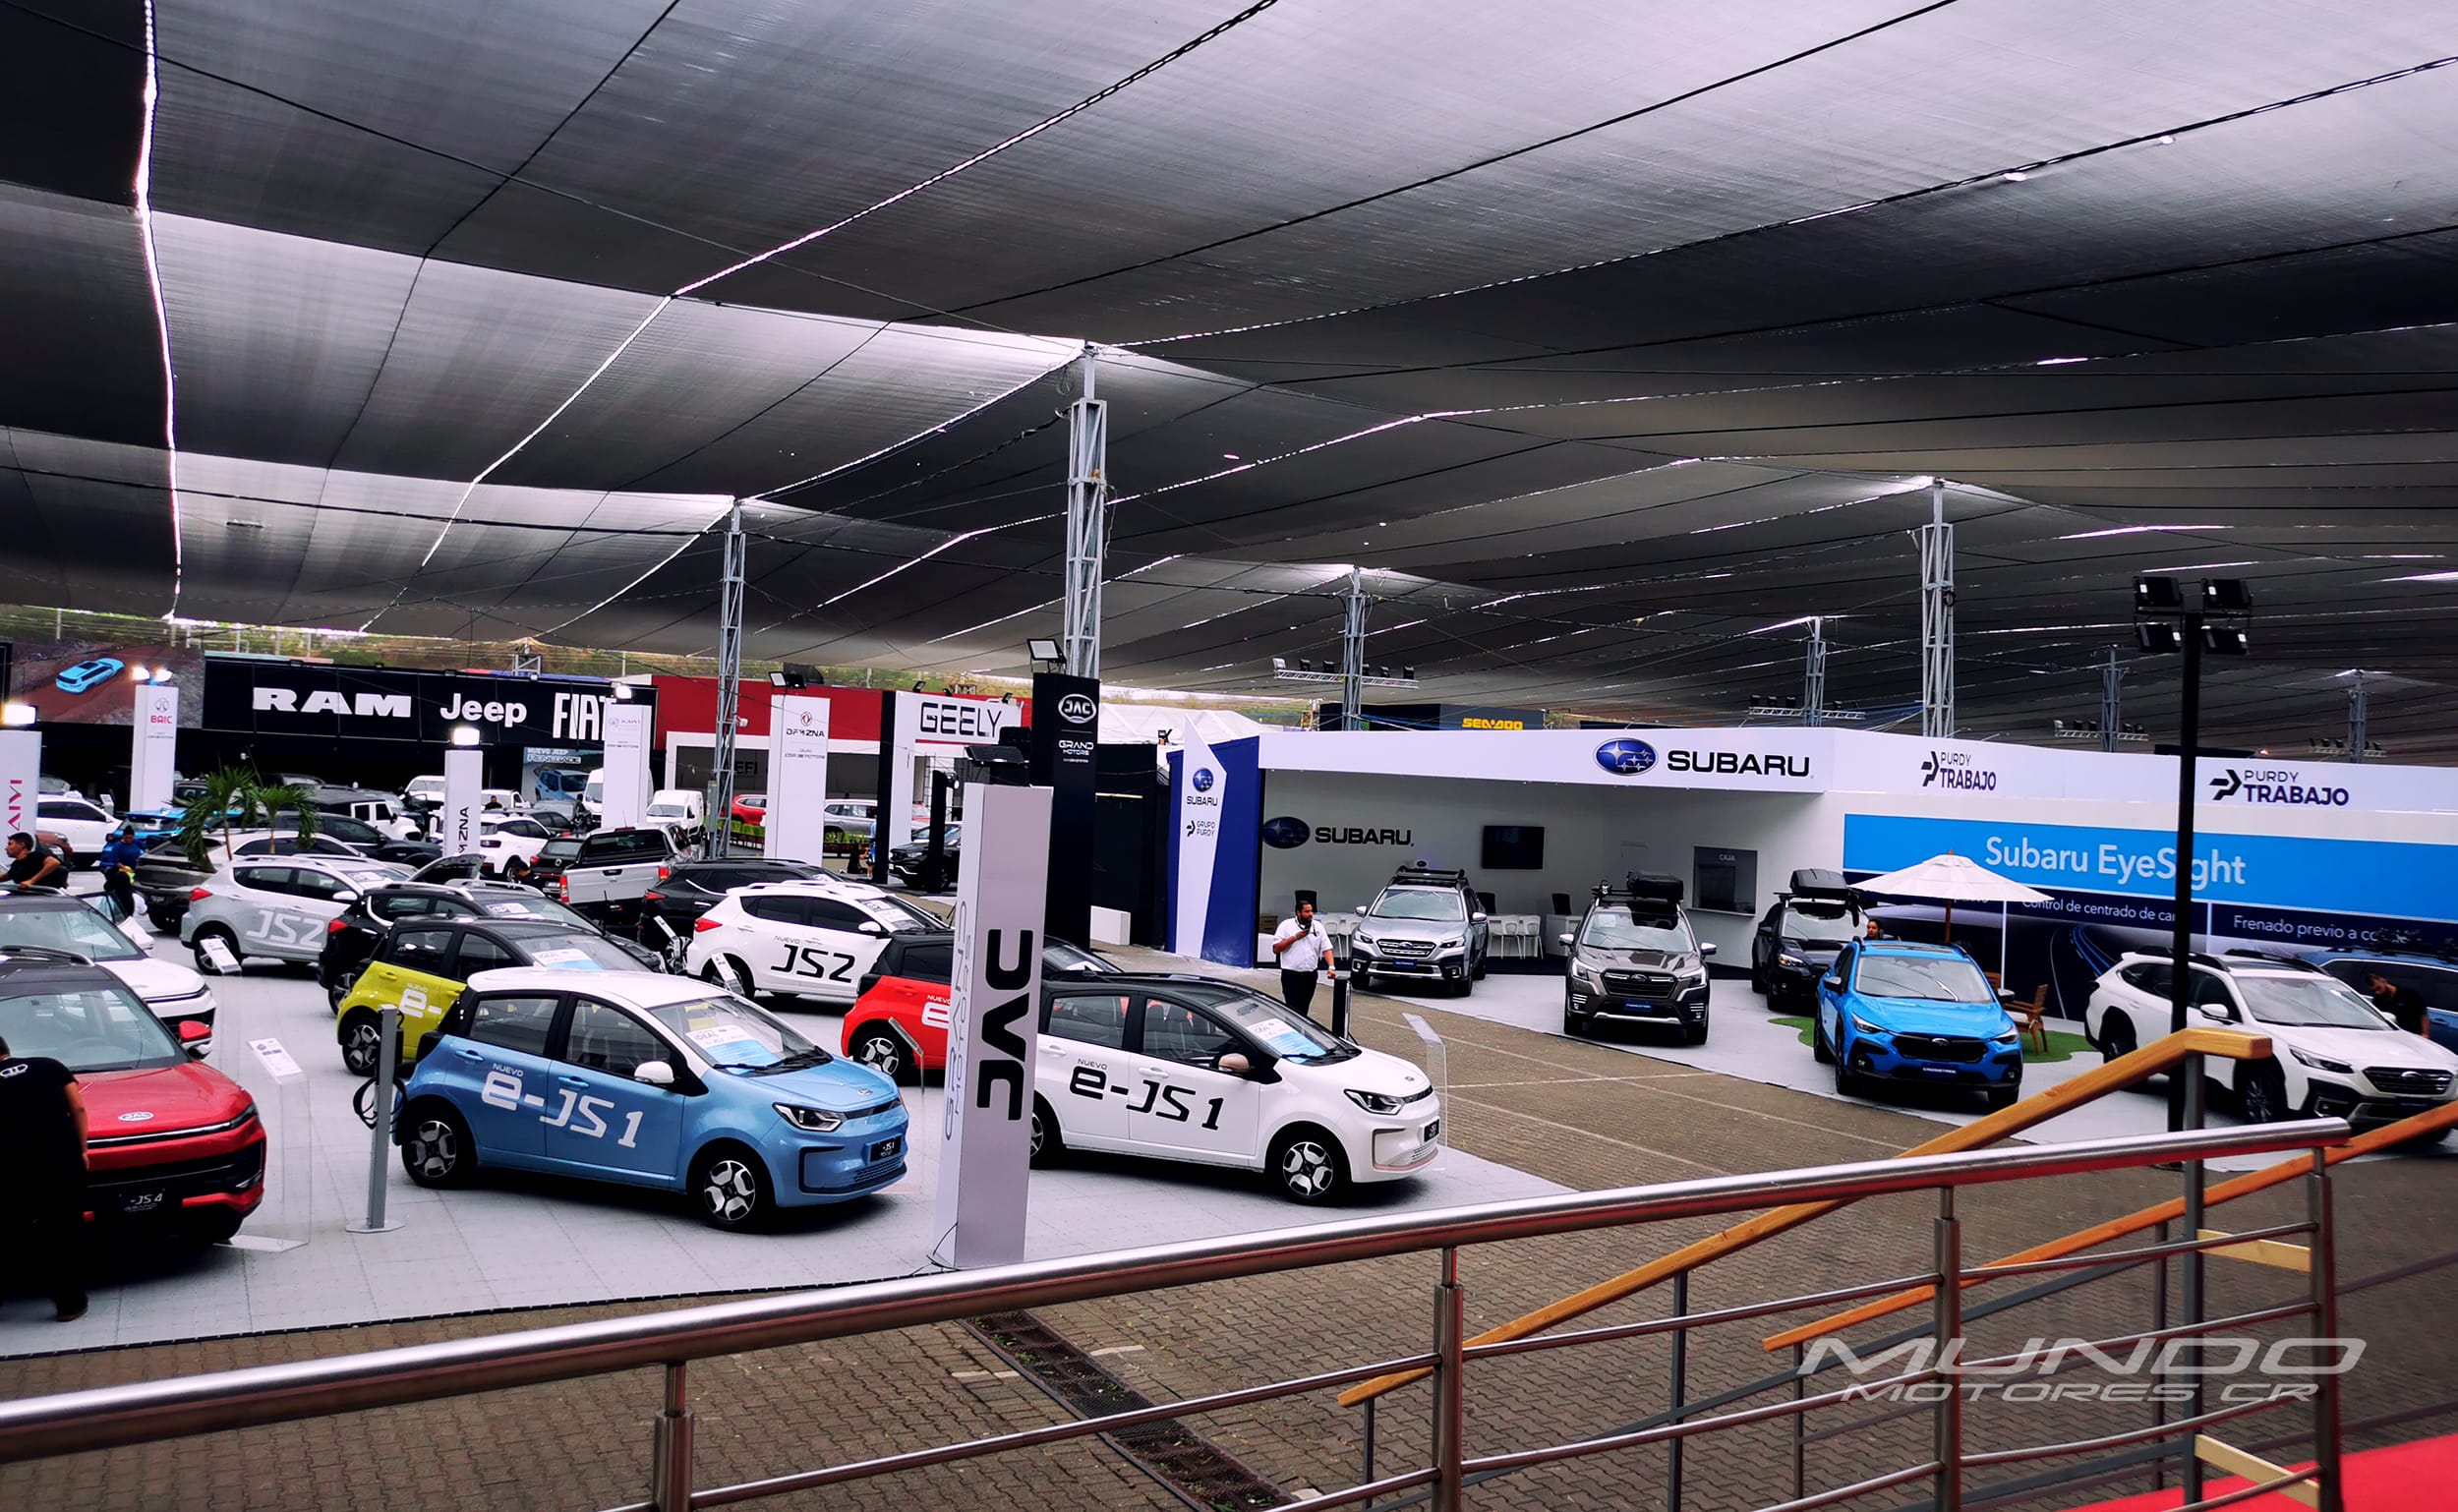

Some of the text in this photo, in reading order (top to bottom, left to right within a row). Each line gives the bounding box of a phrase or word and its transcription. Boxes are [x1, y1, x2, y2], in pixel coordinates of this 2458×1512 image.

[253, 687, 412, 718] RAM
[440, 693, 528, 727] Jeep
[150, 715, 173, 725] BAIC
[553, 692, 617, 741] FIAT
[920, 702, 1003, 738] GEELY
[1058, 739, 1094, 750] GRAND
[1668, 750, 1810, 777] SUBARU
[1940, 752, 1971, 766] PURDY
[1940, 768, 1997, 790] TRABAJO
[2244, 770, 2299, 783] PURDY
[1186, 795, 1218, 806] SUBARU
[2243, 785, 2350, 806] TRABAJO
[1315, 827, 1412, 845] SUBARU
[1985, 836, 2247, 892] Subaru EyeSght
[2066, 900, 2081, 912] de
[2083, 903, 2136, 920] centrado
[2138, 906, 2156, 920] de
[246, 909, 325, 947] JS2
[2233, 914, 2294, 933] Frenado
[2297, 923, 2344, 938] previo
[2348, 929, 2357, 940] a
[774, 935, 800, 945] NUEVO
[770, 944, 855, 983] JS2
[976, 928, 1034, 1122] JAC
[493, 1063, 524, 1077] NUEVO
[1078, 1058, 1108, 1071] NUEVO
